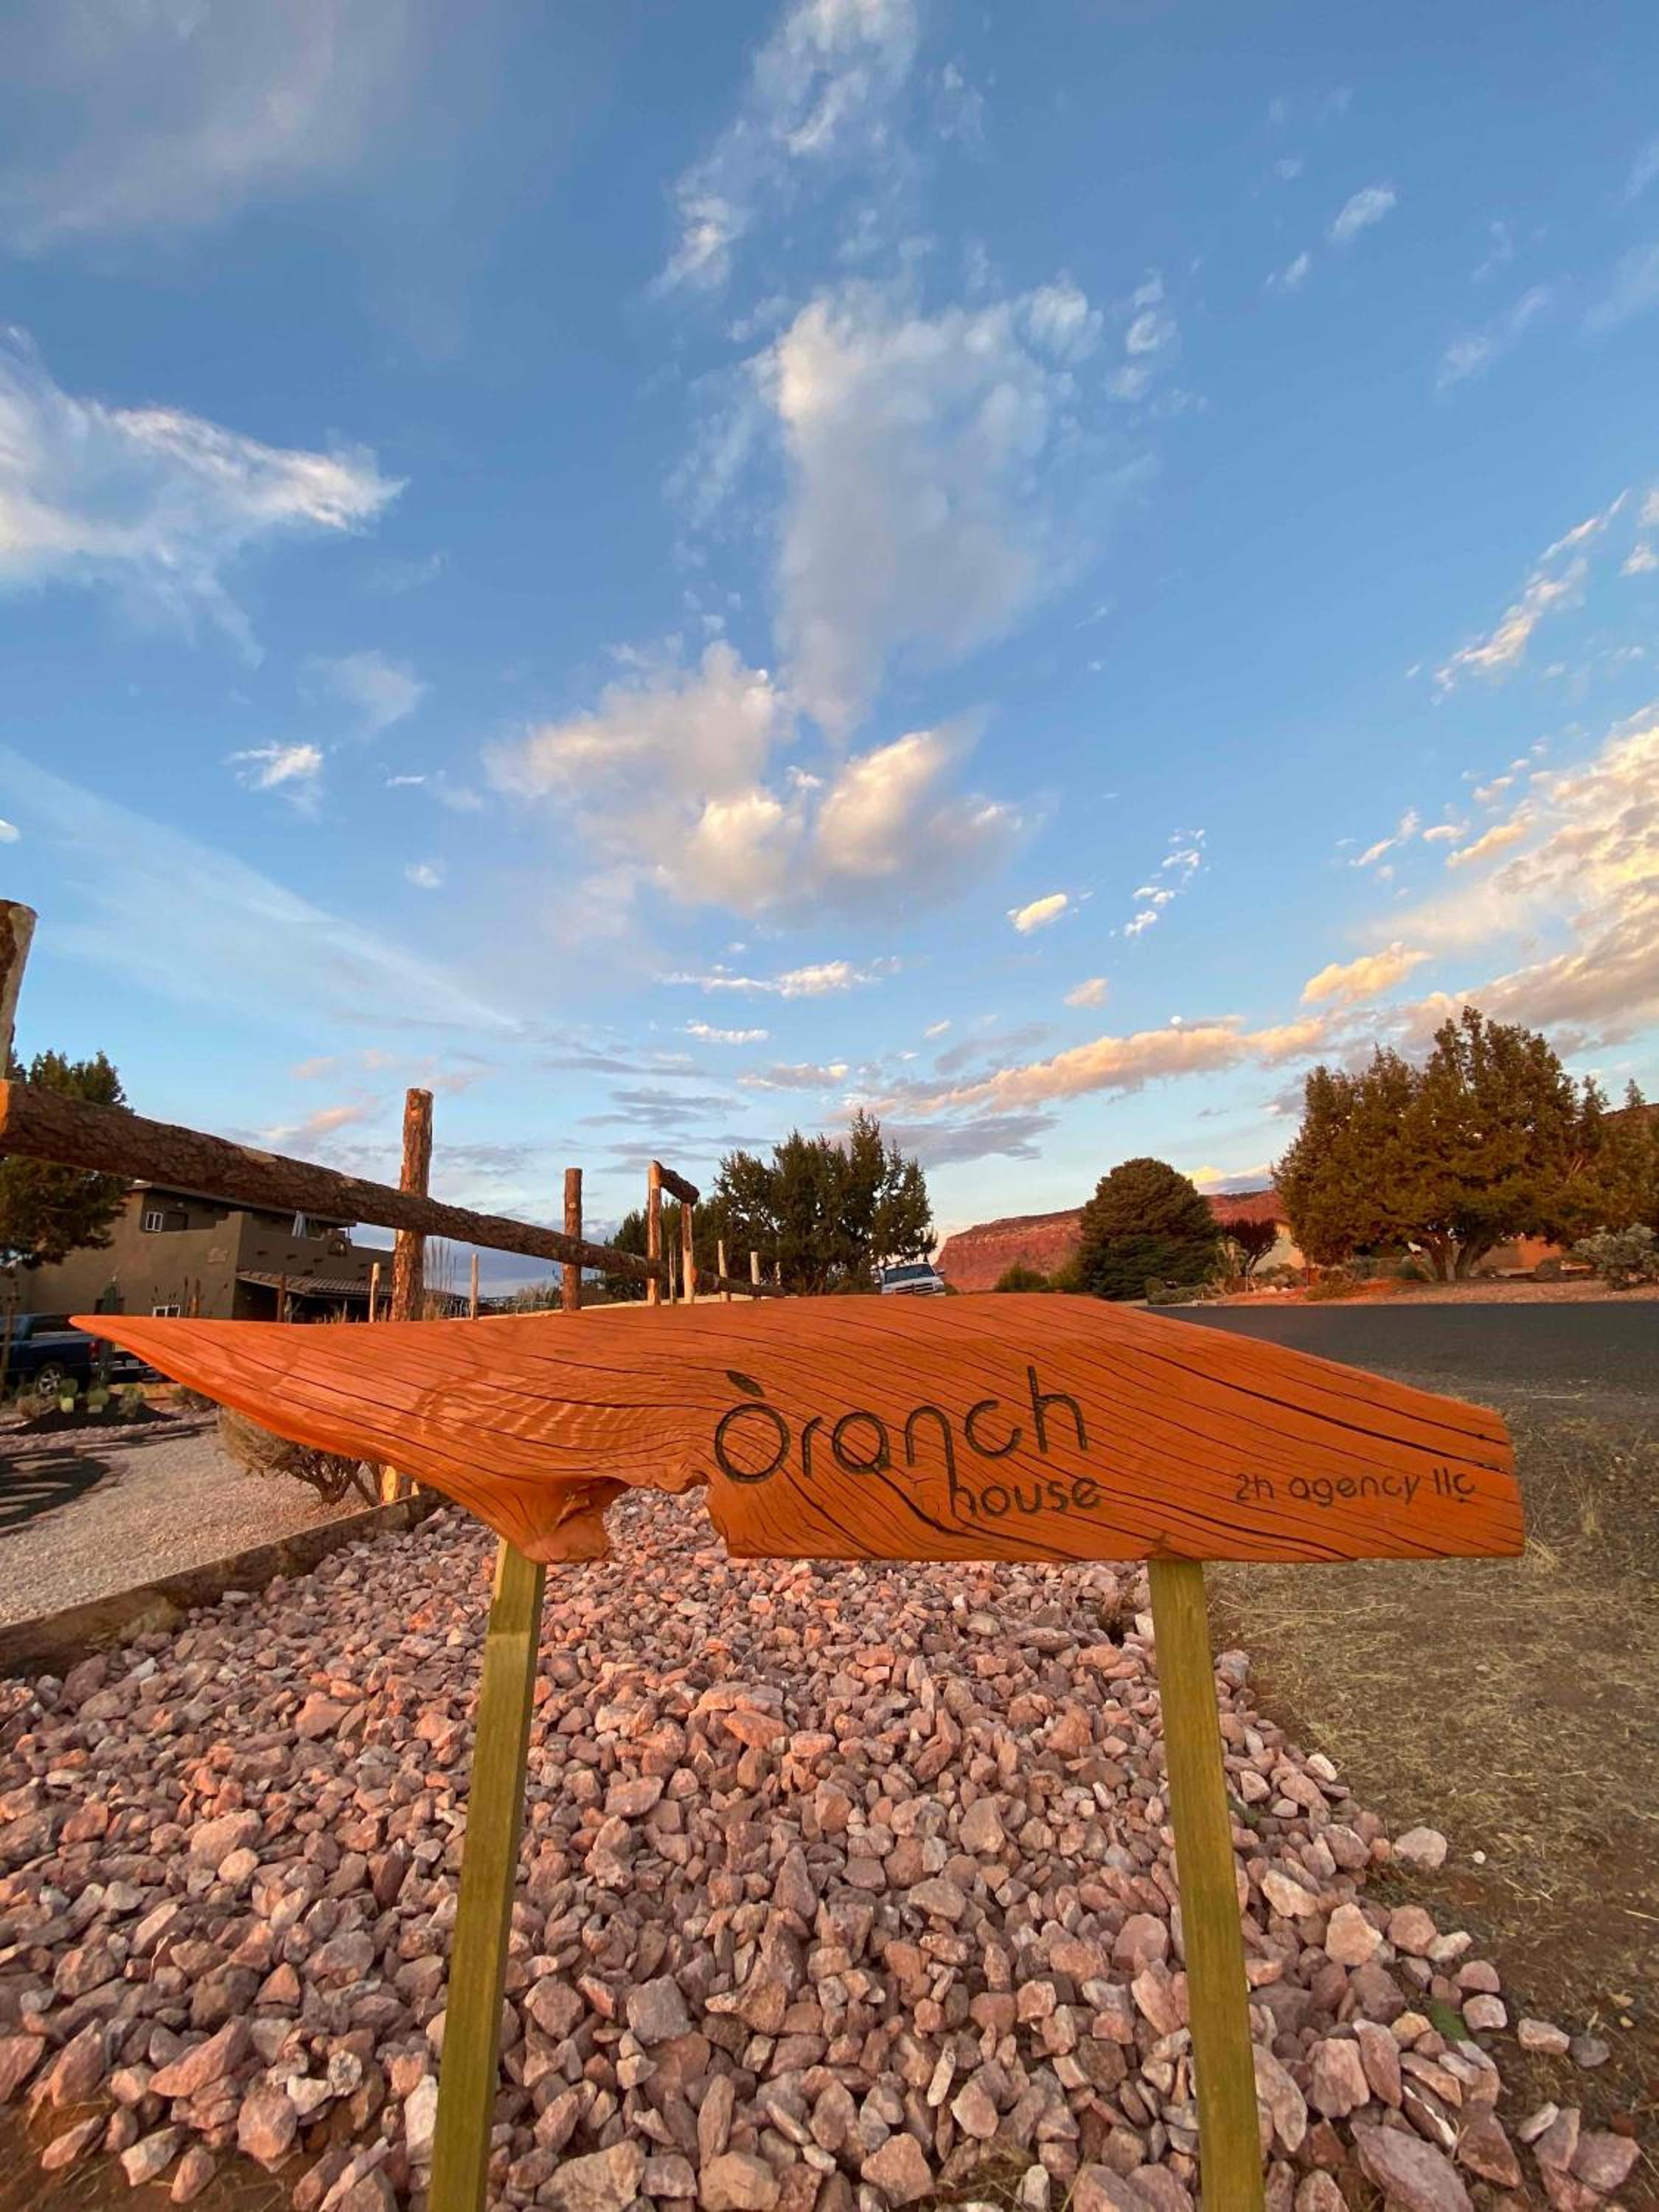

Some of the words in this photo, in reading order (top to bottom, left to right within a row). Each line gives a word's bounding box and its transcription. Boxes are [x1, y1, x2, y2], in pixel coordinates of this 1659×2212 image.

[950, 1477, 1101, 1517] house
[1234, 1473, 1274, 1501] 2h
[1288, 1475, 1420, 1506] agency
[1433, 1468, 1475, 1496] llc
